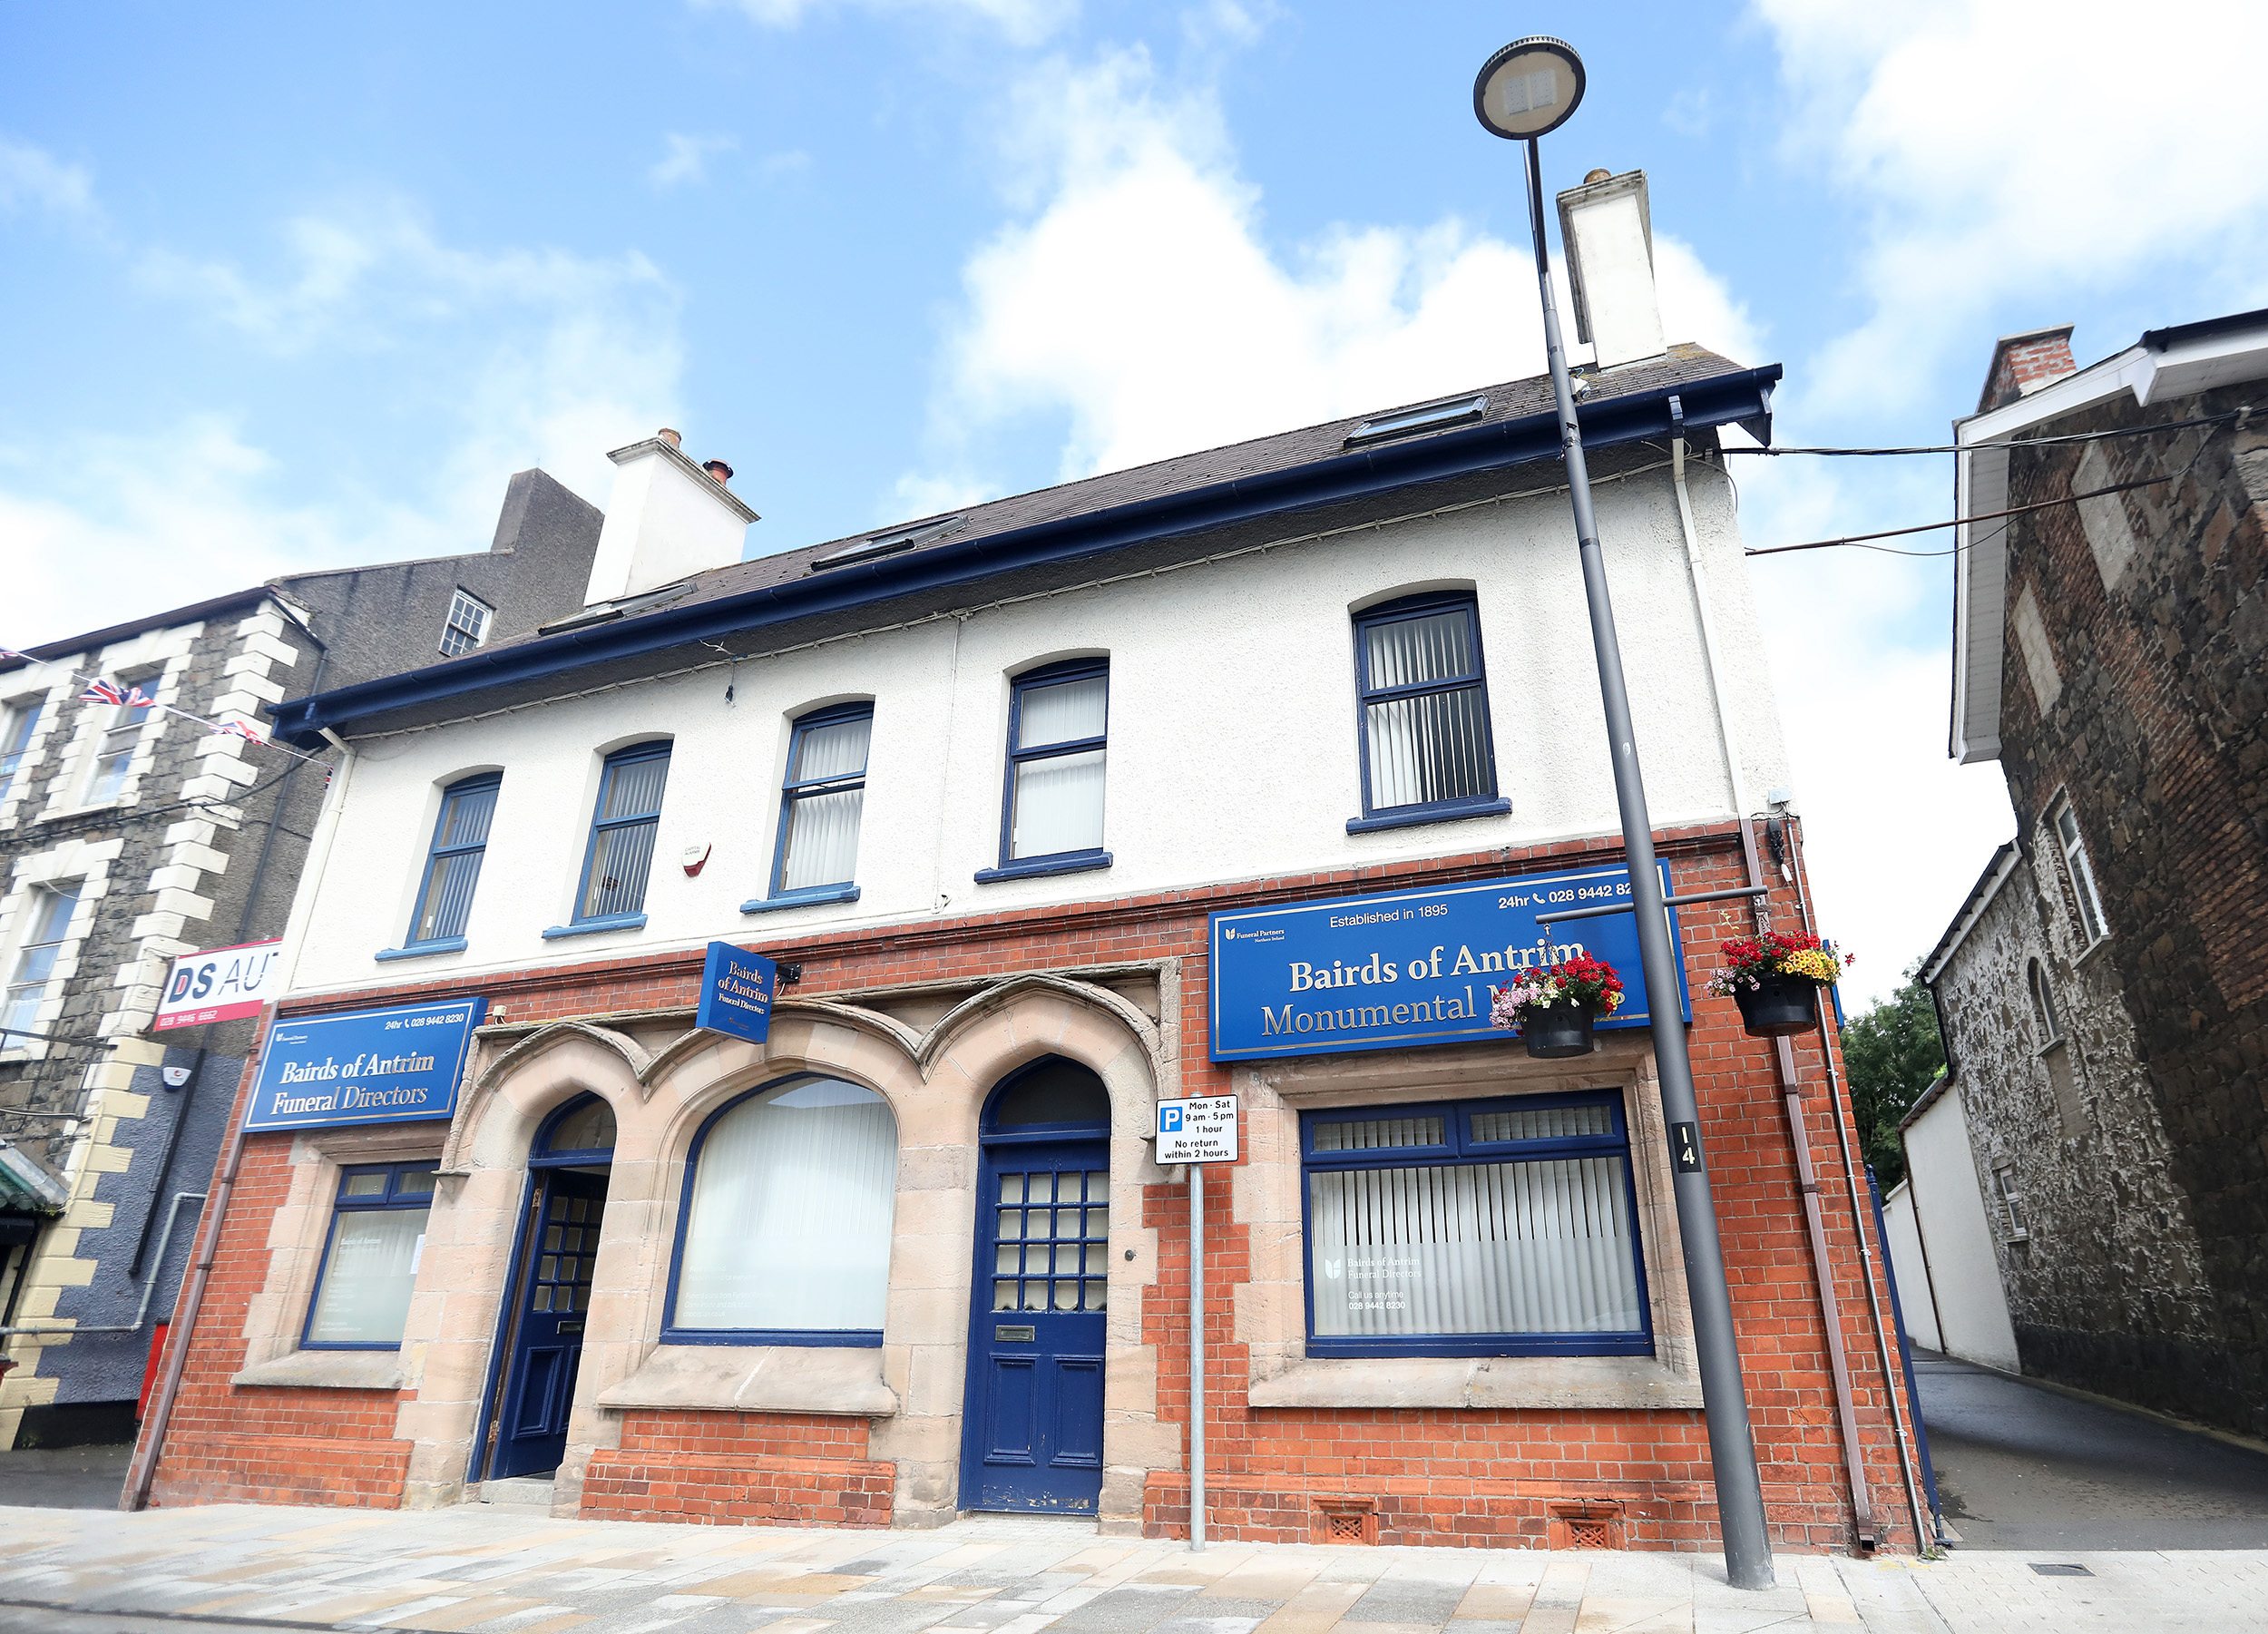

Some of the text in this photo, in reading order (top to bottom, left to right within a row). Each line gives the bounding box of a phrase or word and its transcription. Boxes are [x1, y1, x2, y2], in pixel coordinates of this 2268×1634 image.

[1498, 883, 1632, 909] 24hr 028 9442 82
[1330, 904, 1448, 929] Established in 1895
[1237, 929, 1285, 939] Funeral Partners
[728, 960, 763, 985] Bairds
[1288, 938, 1585, 993] Bairds of Antrim
[168, 952, 279, 1003] DS AU
[718, 976, 768, 1003] of Antrim
[719, 993, 765, 1014] Funeral Directors
[1261, 985, 1478, 1037] Monumental
[385, 1013, 464, 1030] 24hr 028 9442 8230
[279, 1051, 435, 1084] Bairds of Antrim
[270, 1084, 428, 1115] Funeral Directors
[1189, 1102, 1207, 1111] Mon
[1215, 1101, 1230, 1109] Sat
[1165, 1109, 1180, 1130] P
[1185, 1113, 1191, 1122] 9
[1213, 1112, 1218, 1120] 5
[1220, 1113, 1234, 1121] pm
[1202, 1125, 1223, 1133] hour
[1190, 1140, 1218, 1148] return
[1165, 1149, 1228, 1159] within 2 hours
[1347, 1257, 1420, 1267] Bairds of Antrim
[1348, 1269, 1422, 1279] Funeral Directors
[1348, 1290, 1404, 1300] Call us anytime
[1348, 1301, 1405, 1310] 028 9442 8230
